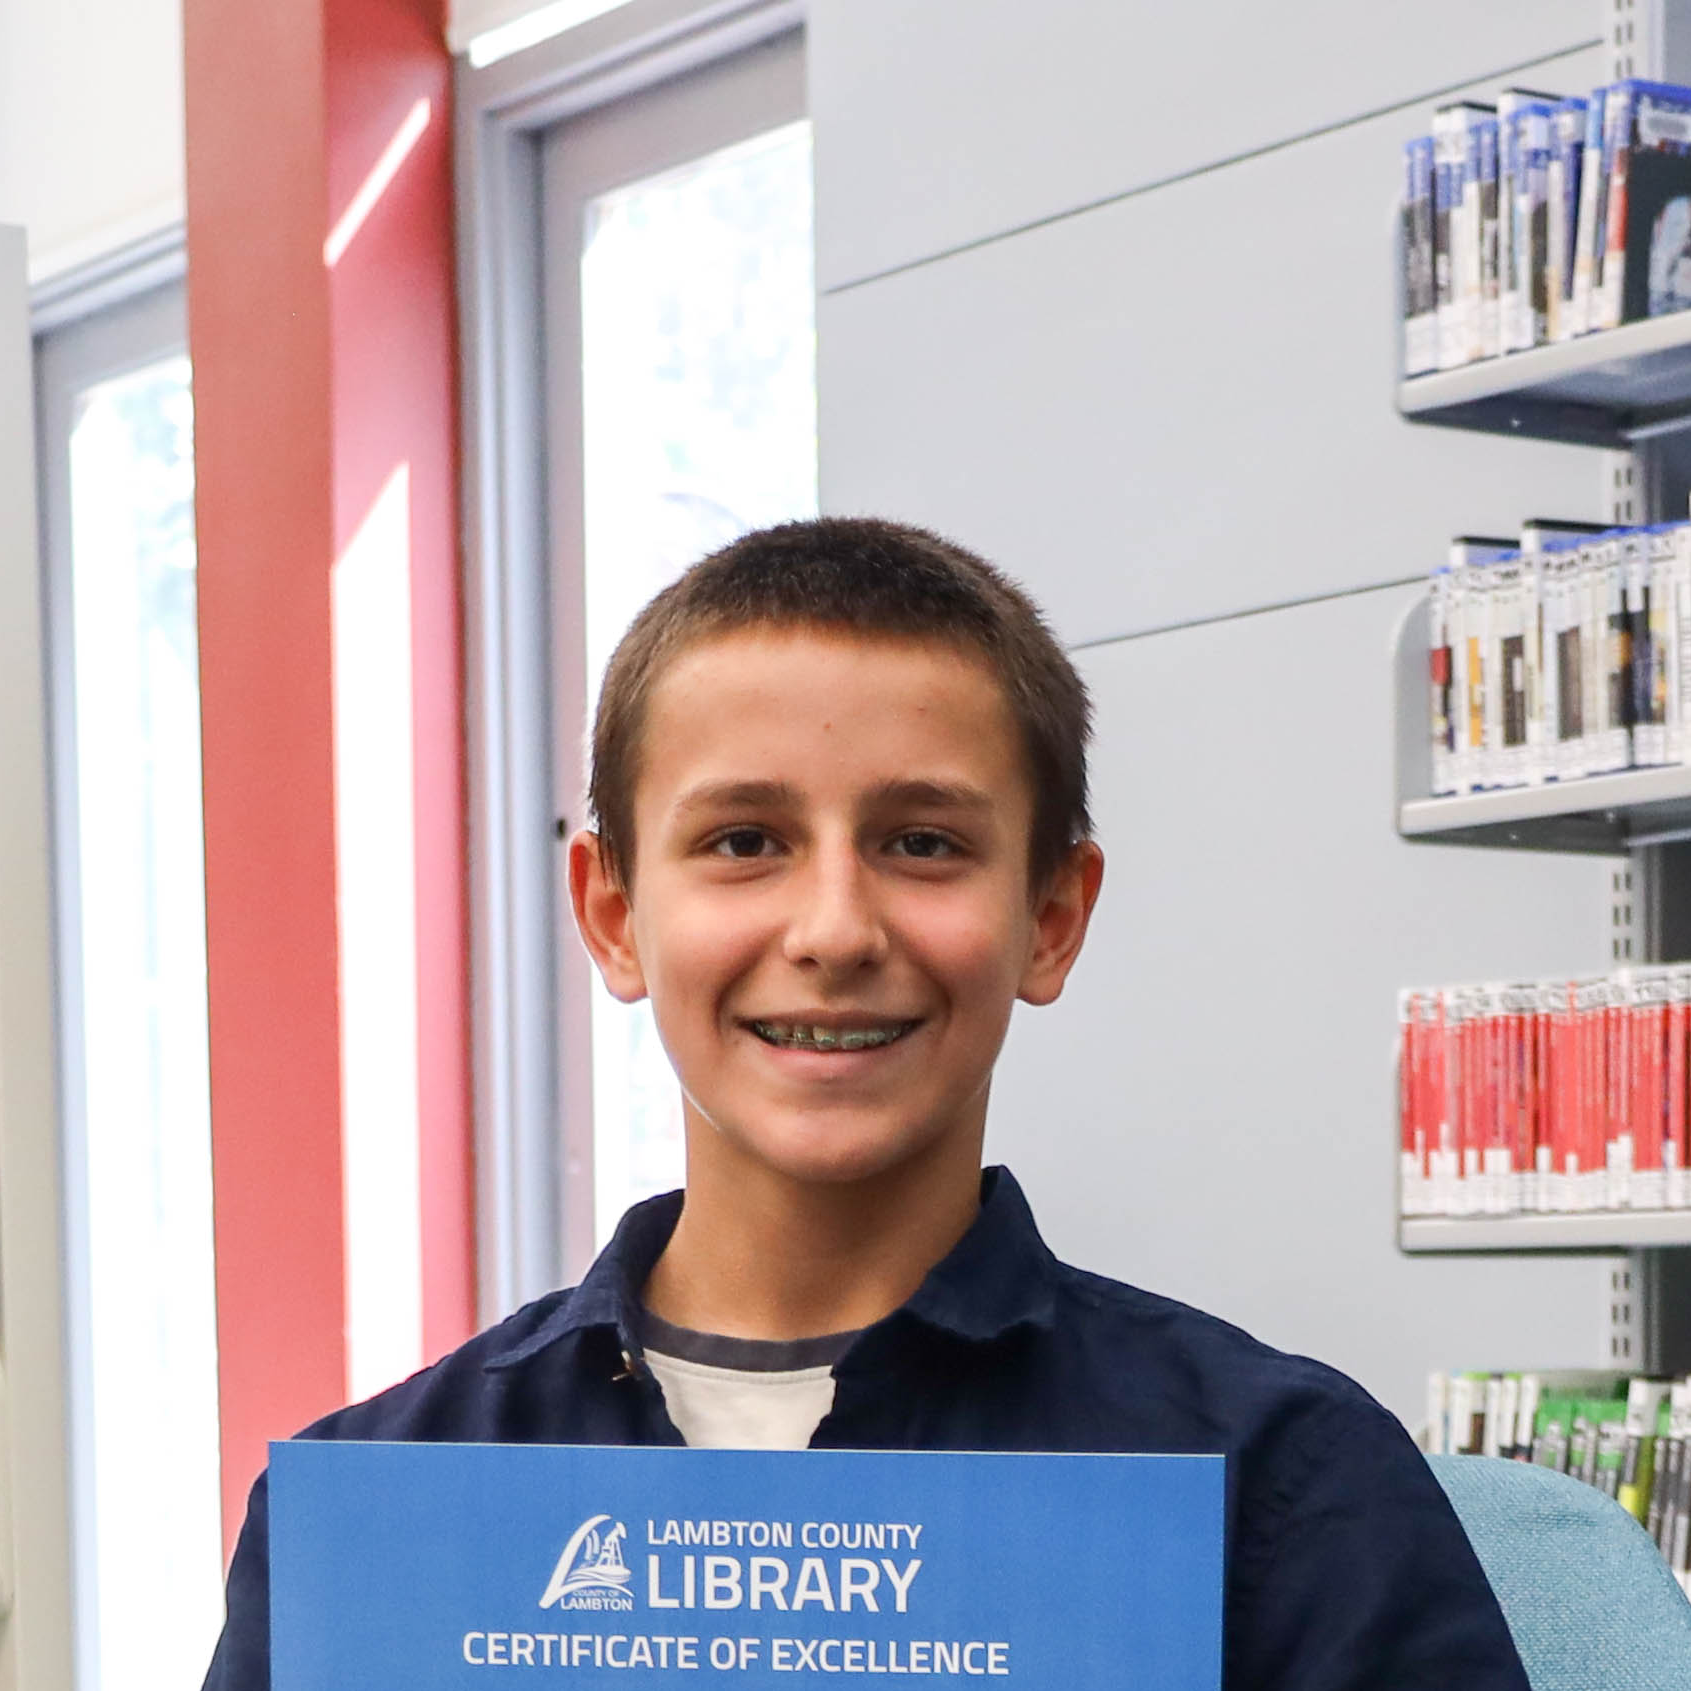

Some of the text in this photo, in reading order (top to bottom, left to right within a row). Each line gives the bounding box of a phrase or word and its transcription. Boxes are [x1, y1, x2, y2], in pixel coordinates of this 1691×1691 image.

[647, 1519, 923, 1550] LAMBTON COUNTY
[574, 1589, 609, 1597] COUNTY
[648, 1554, 922, 1613] LIBRARY
[560, 1598, 633, 1611] LAMBTON
[462, 1631, 1010, 1675] CERTIFICATE OF EXCELLENCE
